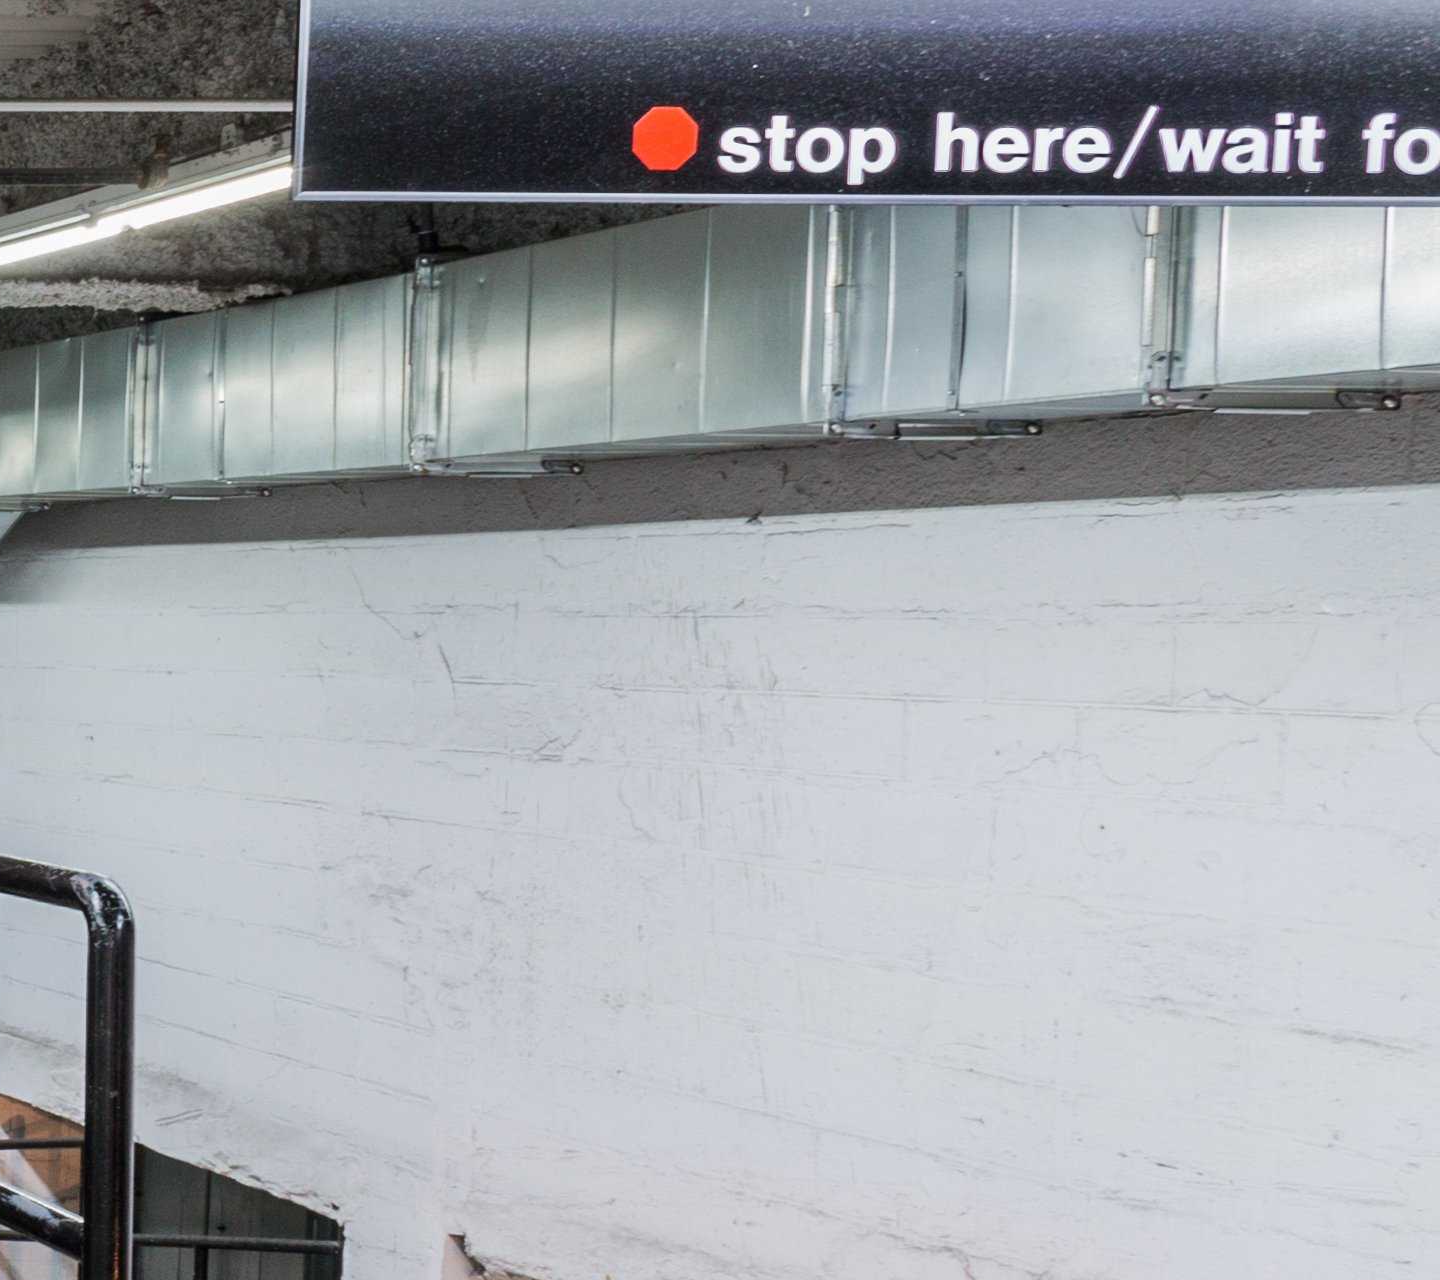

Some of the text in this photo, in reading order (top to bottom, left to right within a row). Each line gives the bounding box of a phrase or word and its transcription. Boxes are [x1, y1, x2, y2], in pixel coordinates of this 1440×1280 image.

[718, 105, 1440, 186] stop here/wait fo
